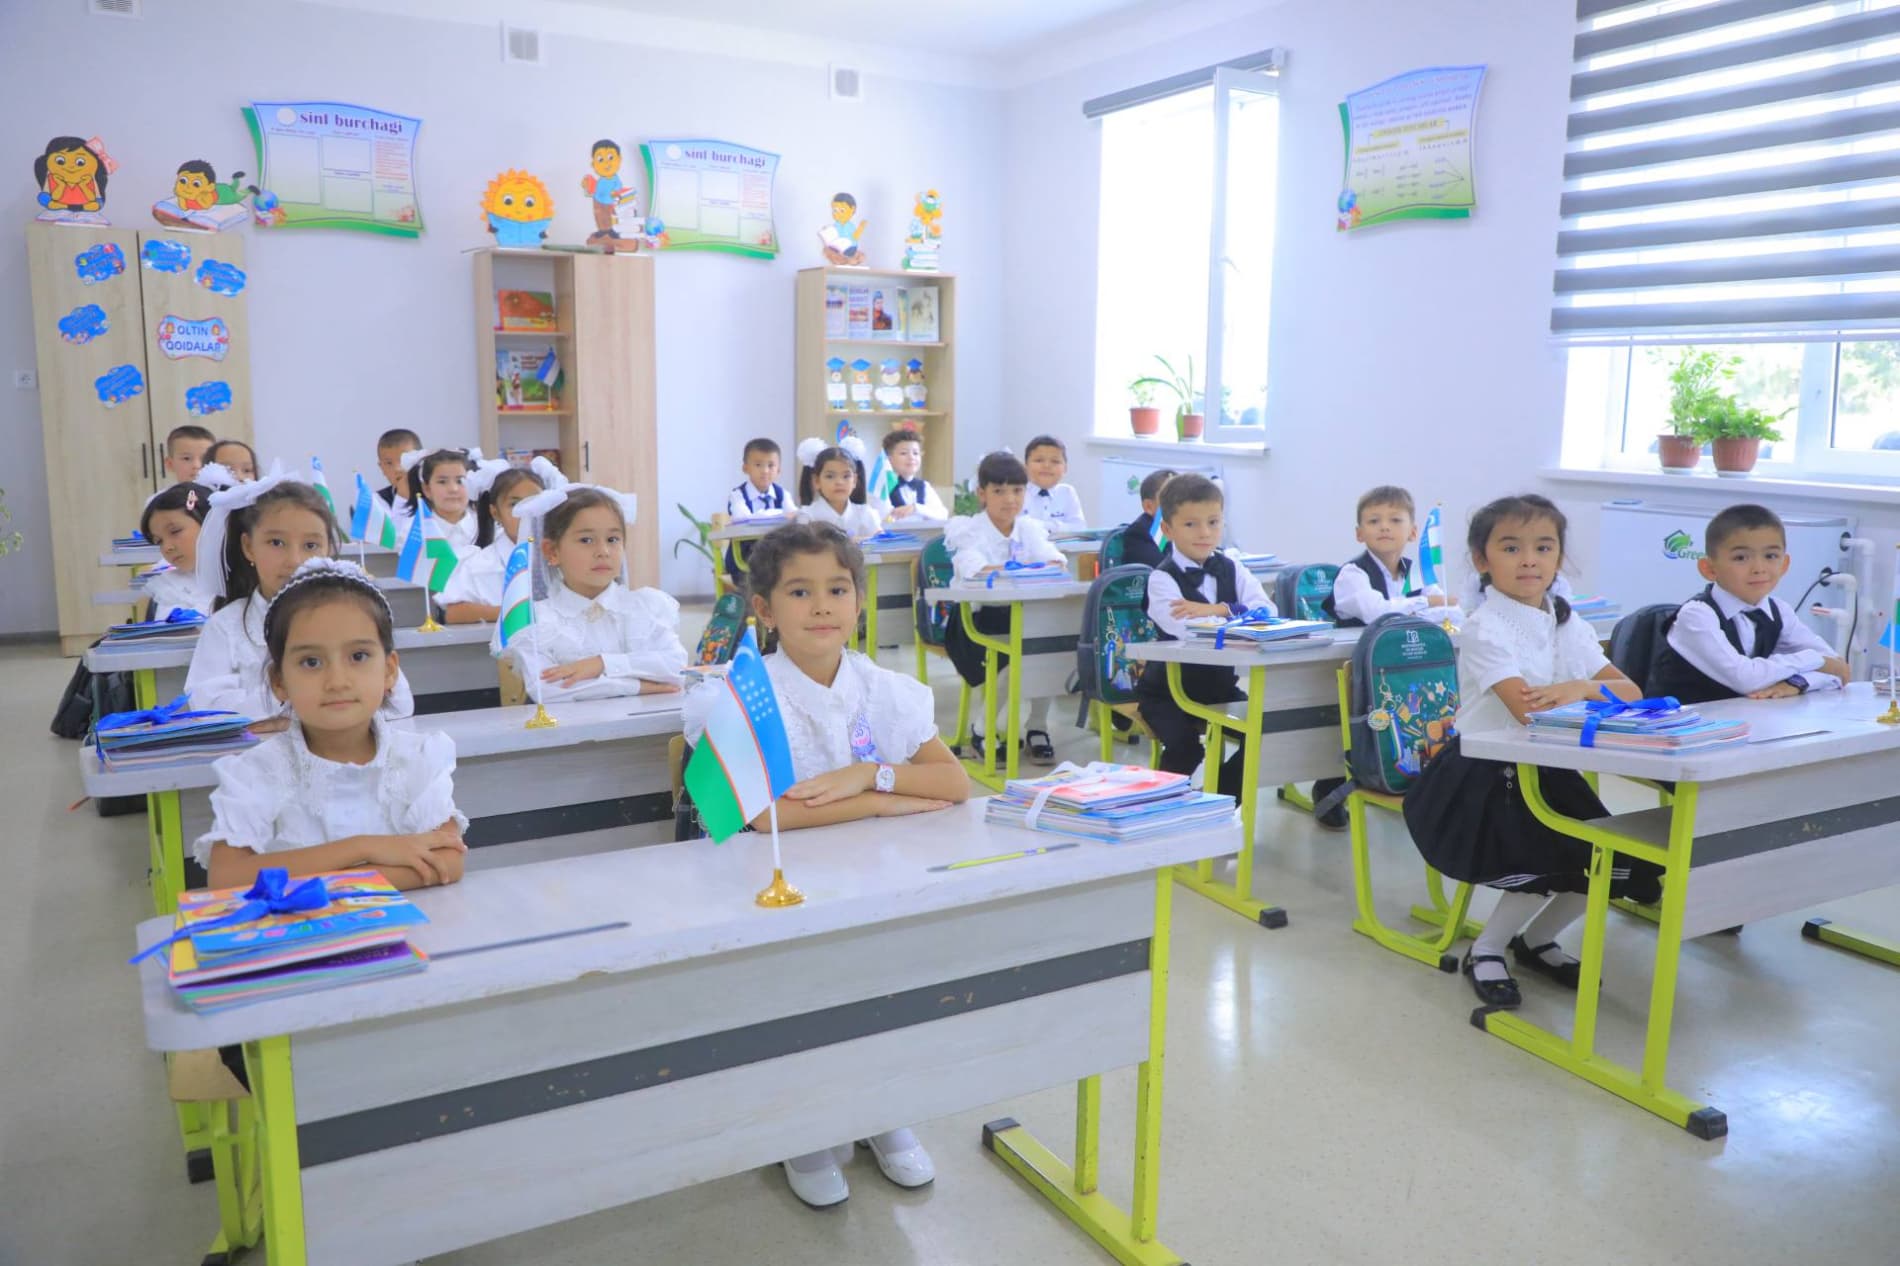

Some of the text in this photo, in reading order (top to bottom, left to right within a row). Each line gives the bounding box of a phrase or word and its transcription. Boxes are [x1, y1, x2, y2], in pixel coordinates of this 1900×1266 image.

[335, 114, 403, 134] burchagi
[177, 325, 209, 336] OLTIN
[166, 340, 221, 352] QOIDALAR
